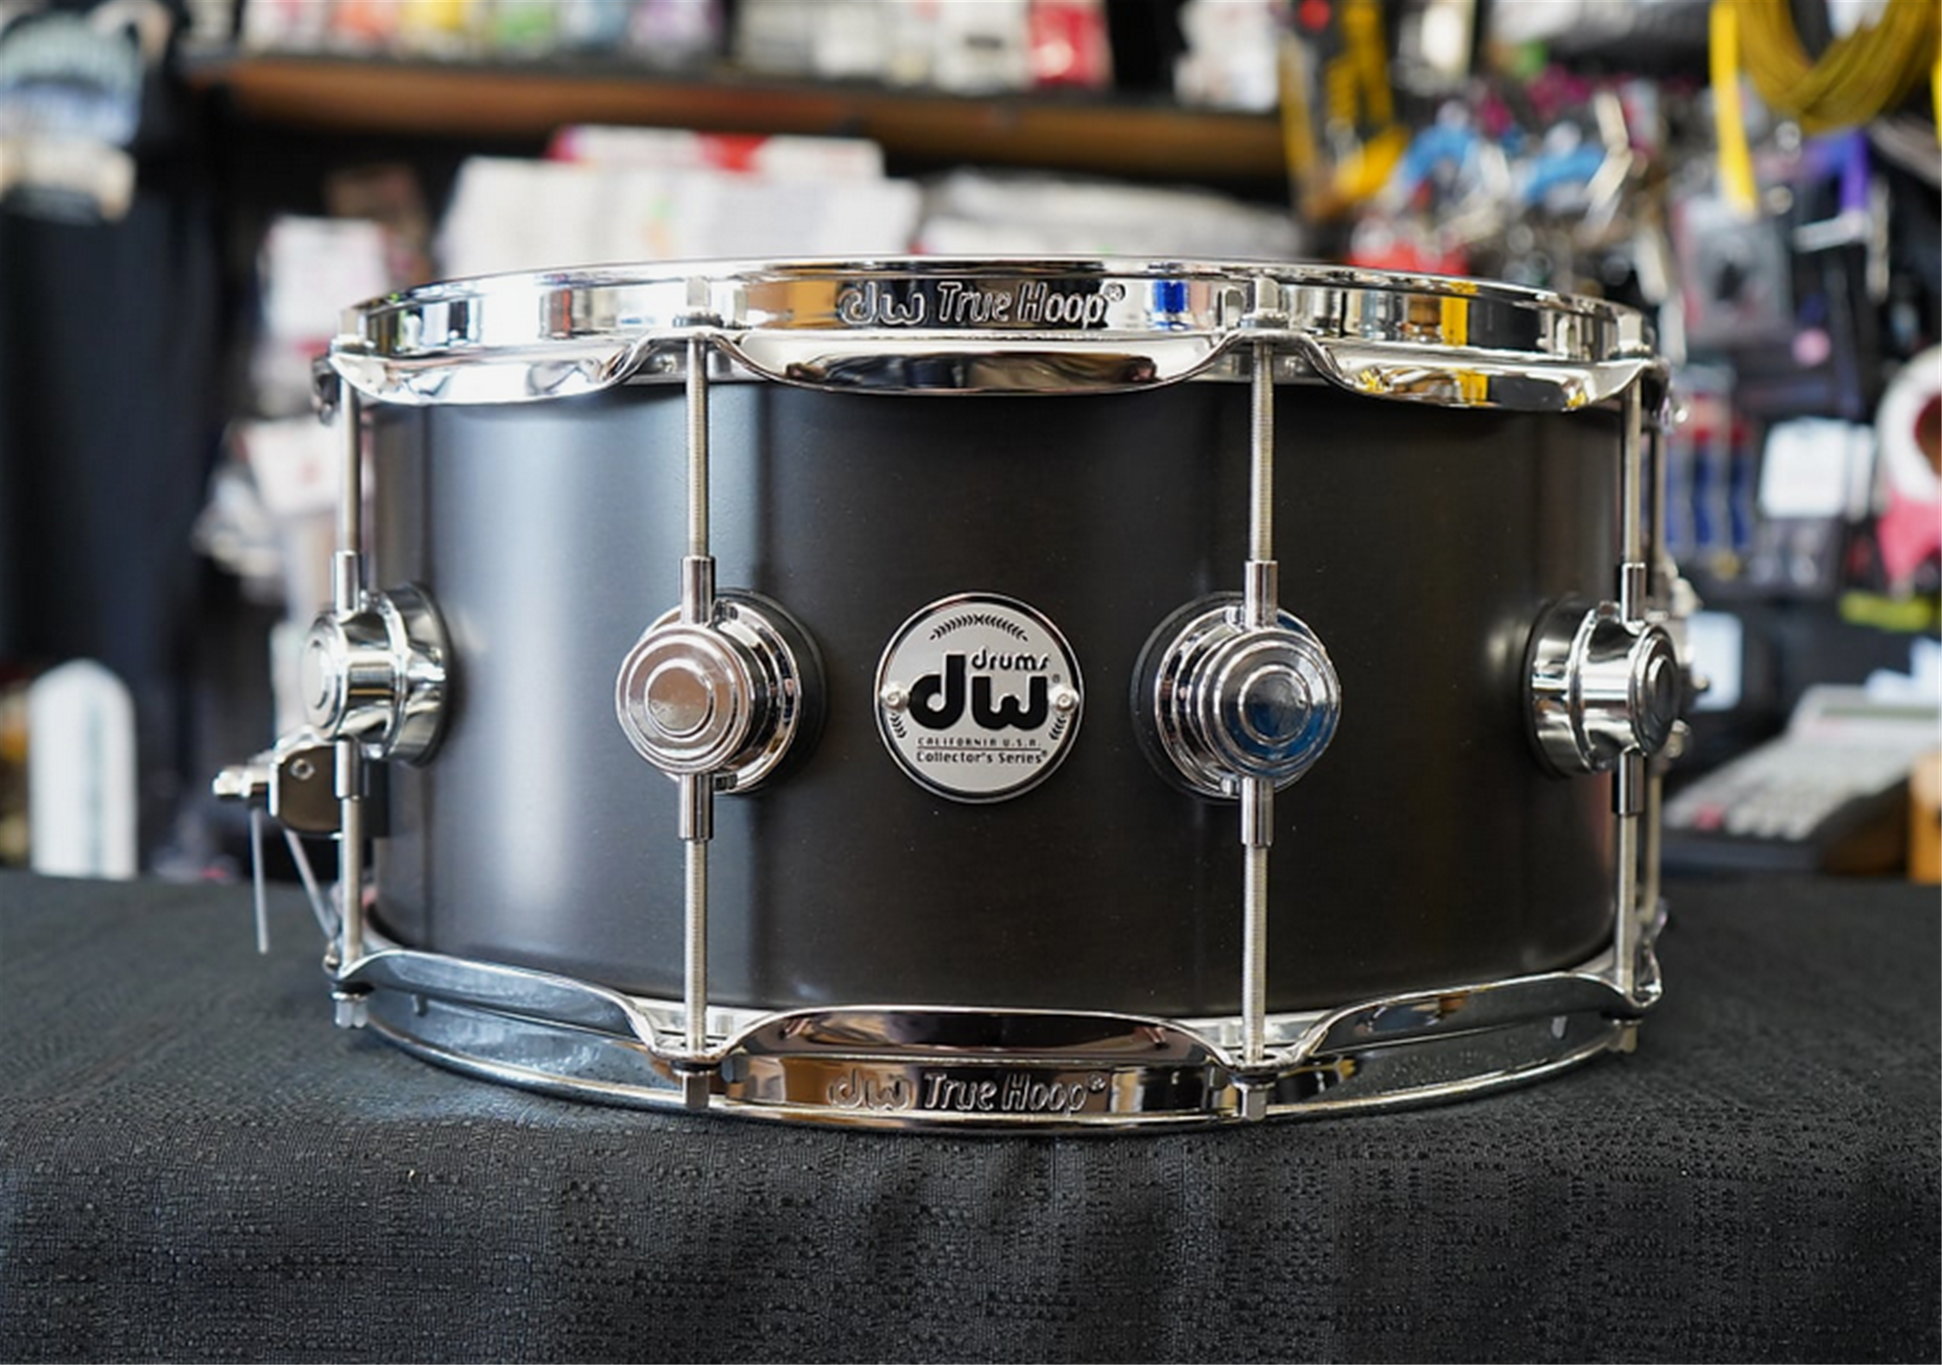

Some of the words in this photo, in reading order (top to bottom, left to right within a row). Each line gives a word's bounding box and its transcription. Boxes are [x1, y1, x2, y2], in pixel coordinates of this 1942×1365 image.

[838, 281, 925, 325] dw
[937, 281, 1013, 323] True
[971, 648, 1050, 671] drums
[916, 751, 994, 764] Collector's
[827, 1068, 916, 1112] dw
[923, 1071, 998, 1112] True
